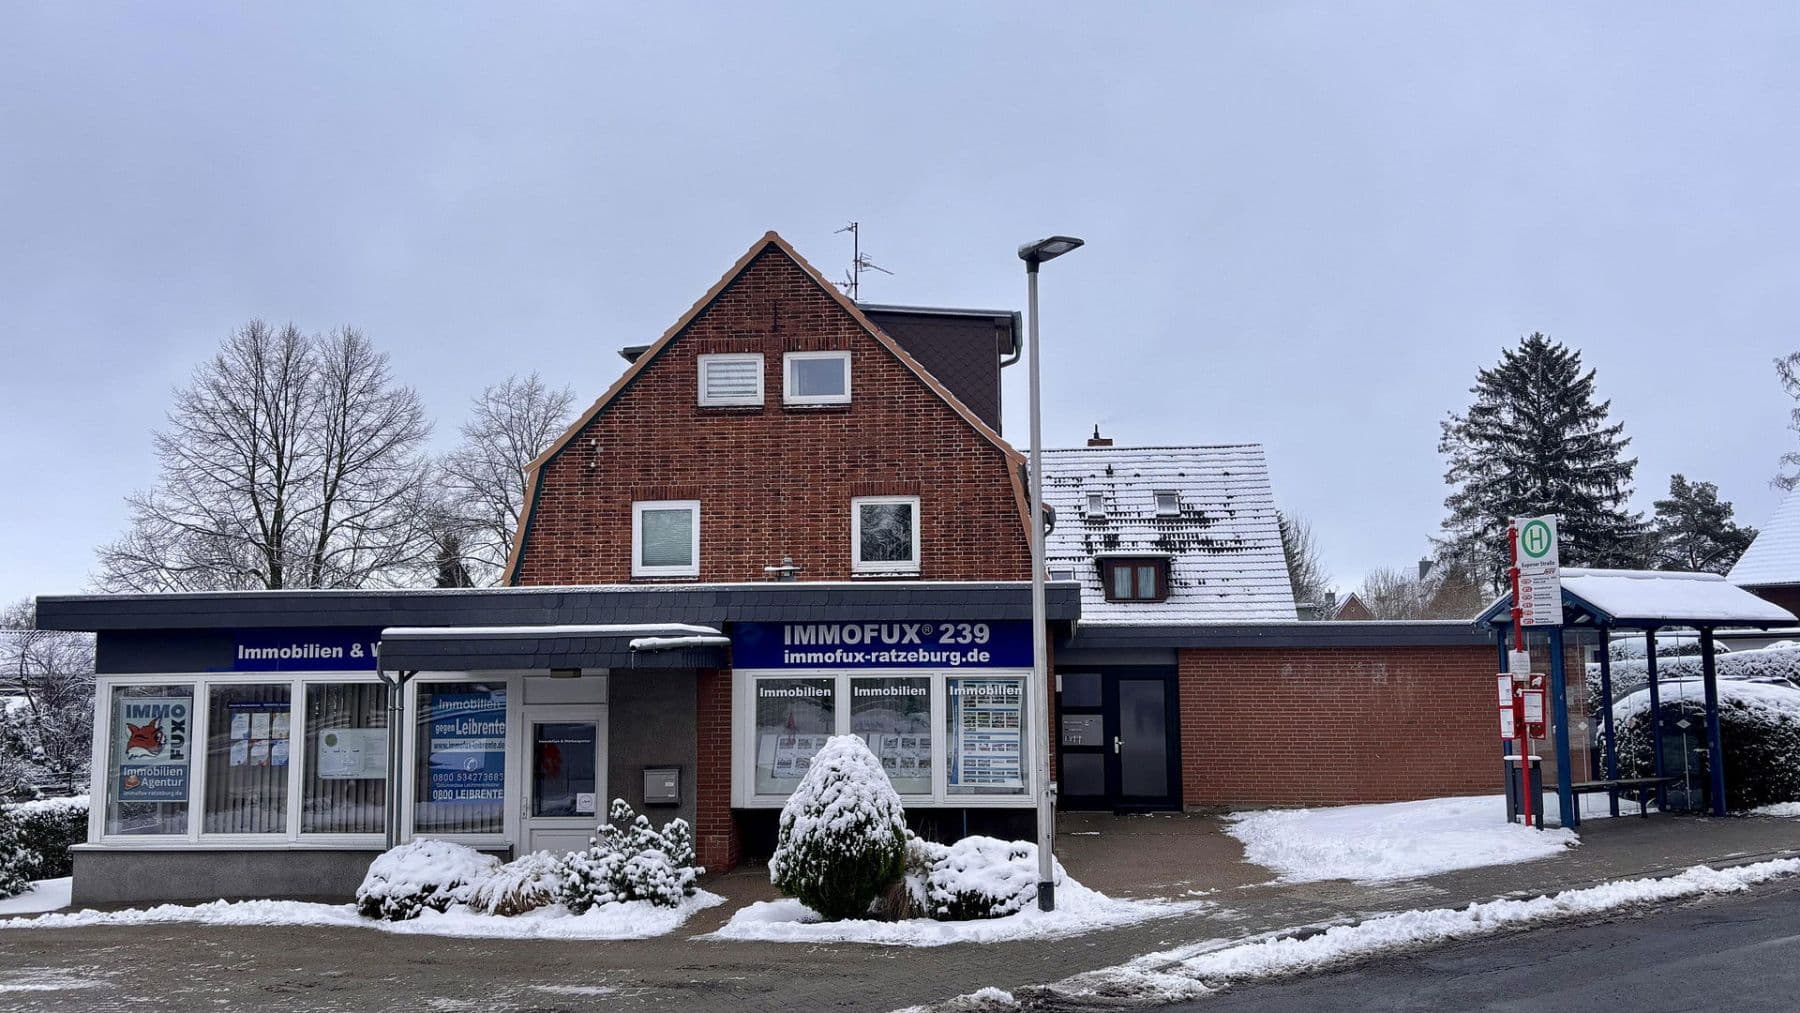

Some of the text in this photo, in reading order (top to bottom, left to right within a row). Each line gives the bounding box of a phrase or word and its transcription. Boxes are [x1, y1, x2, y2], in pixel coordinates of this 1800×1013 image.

[1530, 528, 1543, 550] H
[939, 623, 990, 644] 239
[238, 644, 343, 659] Immobilien
[350, 643, 364, 658] &
[784, 648, 990, 665] immofux-ratzeburg.de
[759, 687, 832, 698] Immobilien
[854, 685, 927, 697] Immobilien
[949, 685, 1023, 696] Immobilien
[126, 704, 186, 719] IMMO
[435, 718, 505, 735] gegen Leibrente
[170, 719, 186, 760] FUX
[123, 766, 183, 776] Immobilien
[432, 773, 454, 781] 0800
[141, 777, 184, 788] Agentur
[432, 789, 504, 800] 0800 LEIBRENTE
